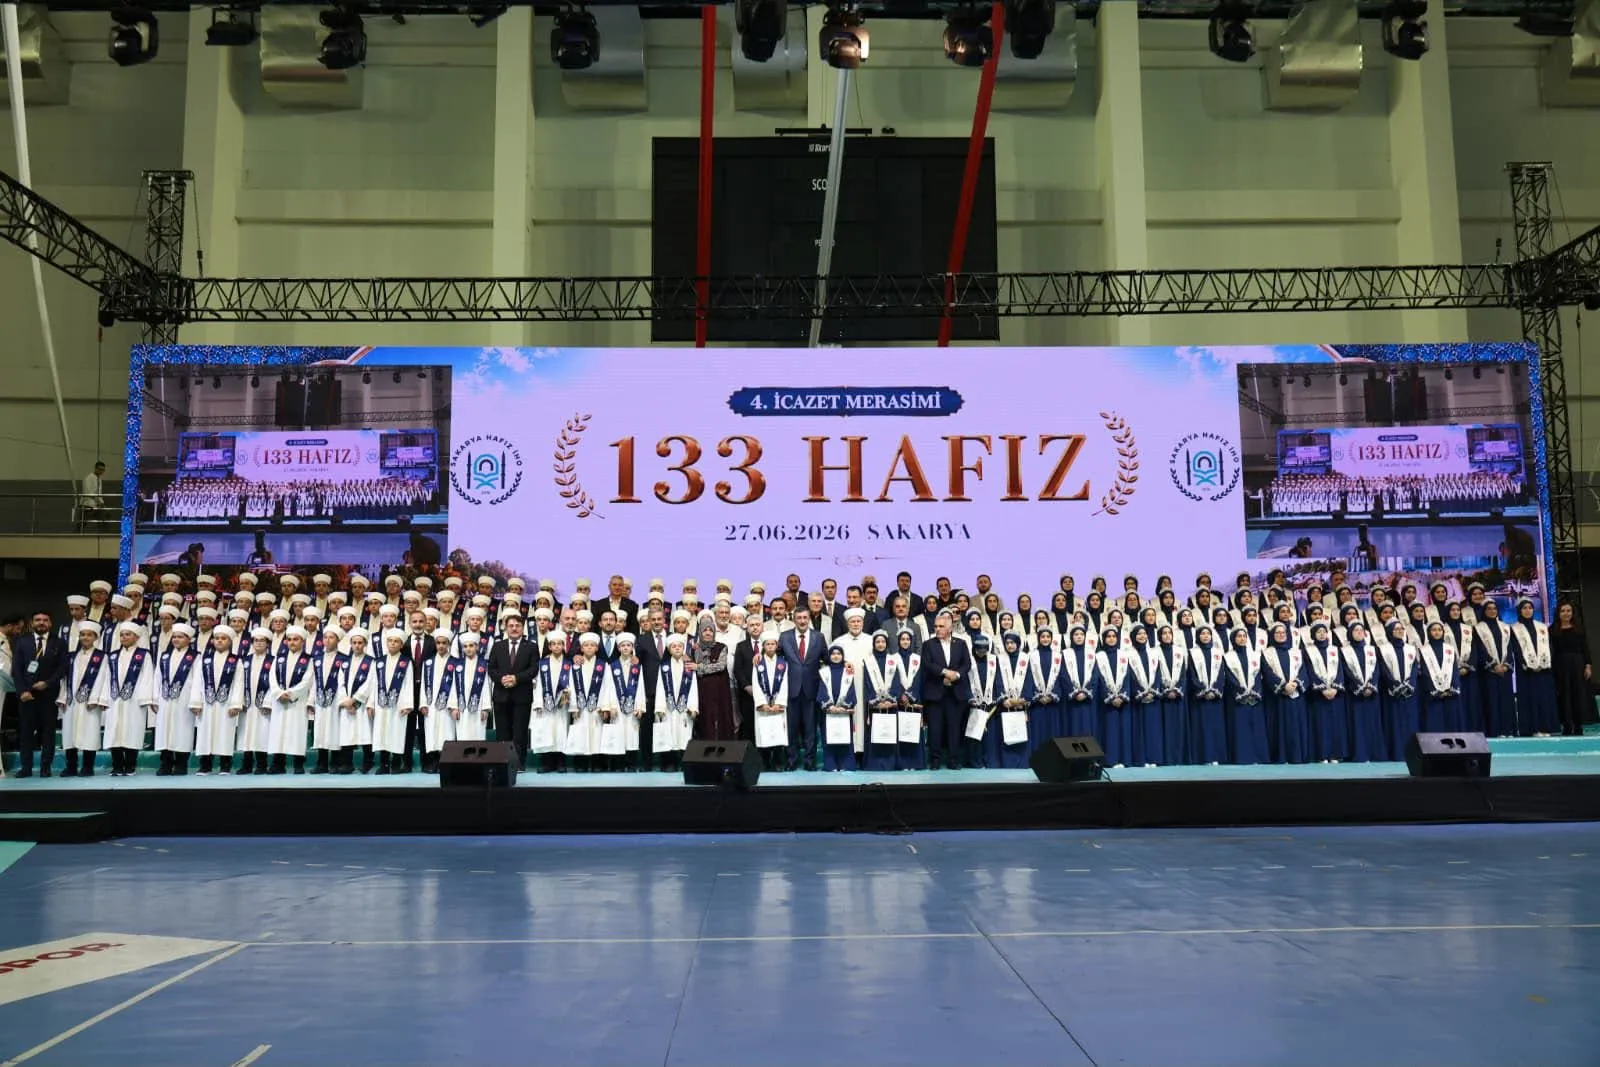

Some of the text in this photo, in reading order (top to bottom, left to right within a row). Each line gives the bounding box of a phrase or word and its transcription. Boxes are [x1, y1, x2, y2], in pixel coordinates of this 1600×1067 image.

[749, 390, 942, 410] 4. İCAZET MERASİMİ
[450, 435, 482, 467] SAKARYA
[608, 434, 1091, 505] 133 HAFIZ
[724, 522, 972, 541] 27.06.2026 SAKARYA
